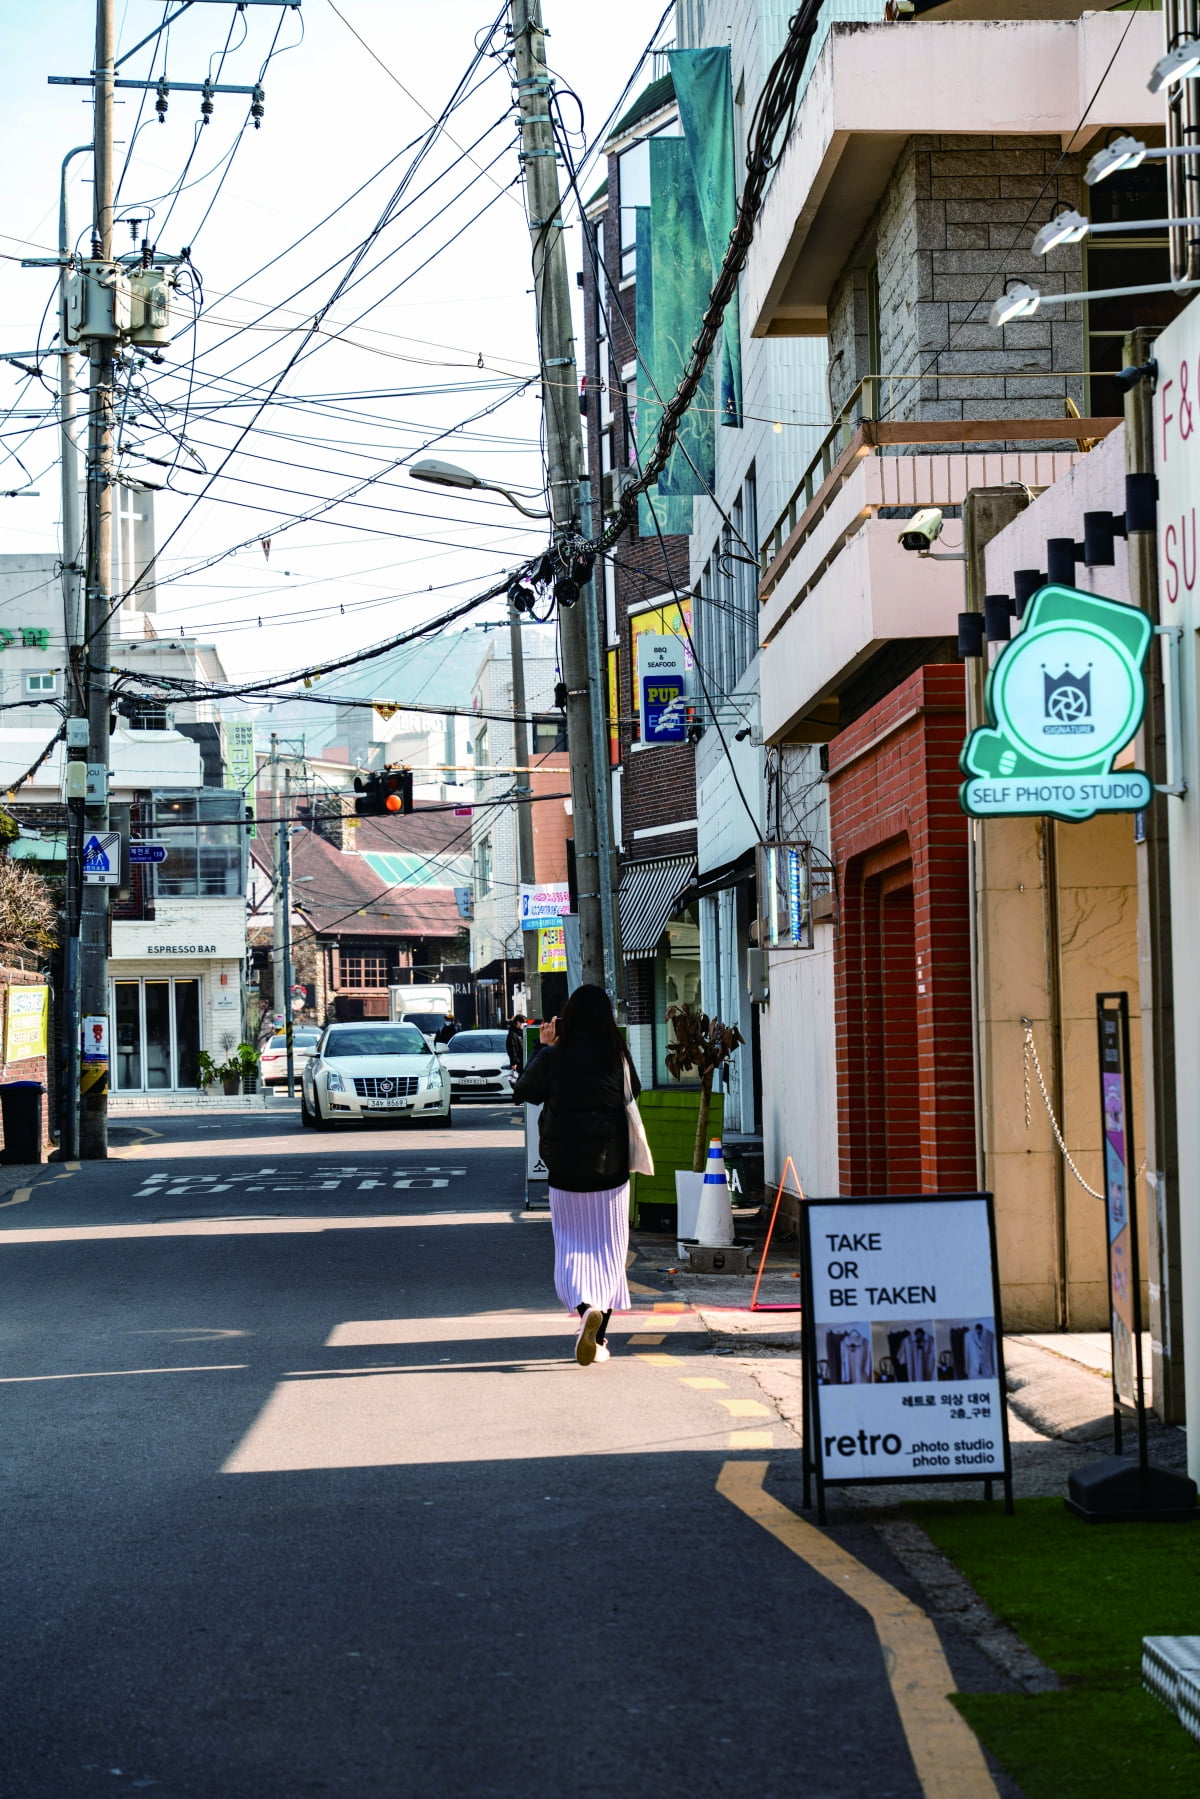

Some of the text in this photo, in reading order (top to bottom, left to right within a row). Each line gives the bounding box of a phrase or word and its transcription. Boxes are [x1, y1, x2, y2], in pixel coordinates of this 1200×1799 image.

[1162, 352, 1200, 462] F&
[1044, 726, 1093, 735] SIGNATURE
[973, 783, 1143, 804] SELF PHOTO STUDIO
[147, 945, 217, 954] ESPRESSO BAR
[825, 1233, 882, 1252] TAKE
[827, 1261, 859, 1280] OR
[829, 1285, 937, 1307] BE TAKEN
[902, 1392, 991, 1407] 레트로 의상 대여
[824, 1429, 902, 1457] retro
[953, 1438, 994, 1453] studio
[912, 1453, 995, 1469] photo studio
